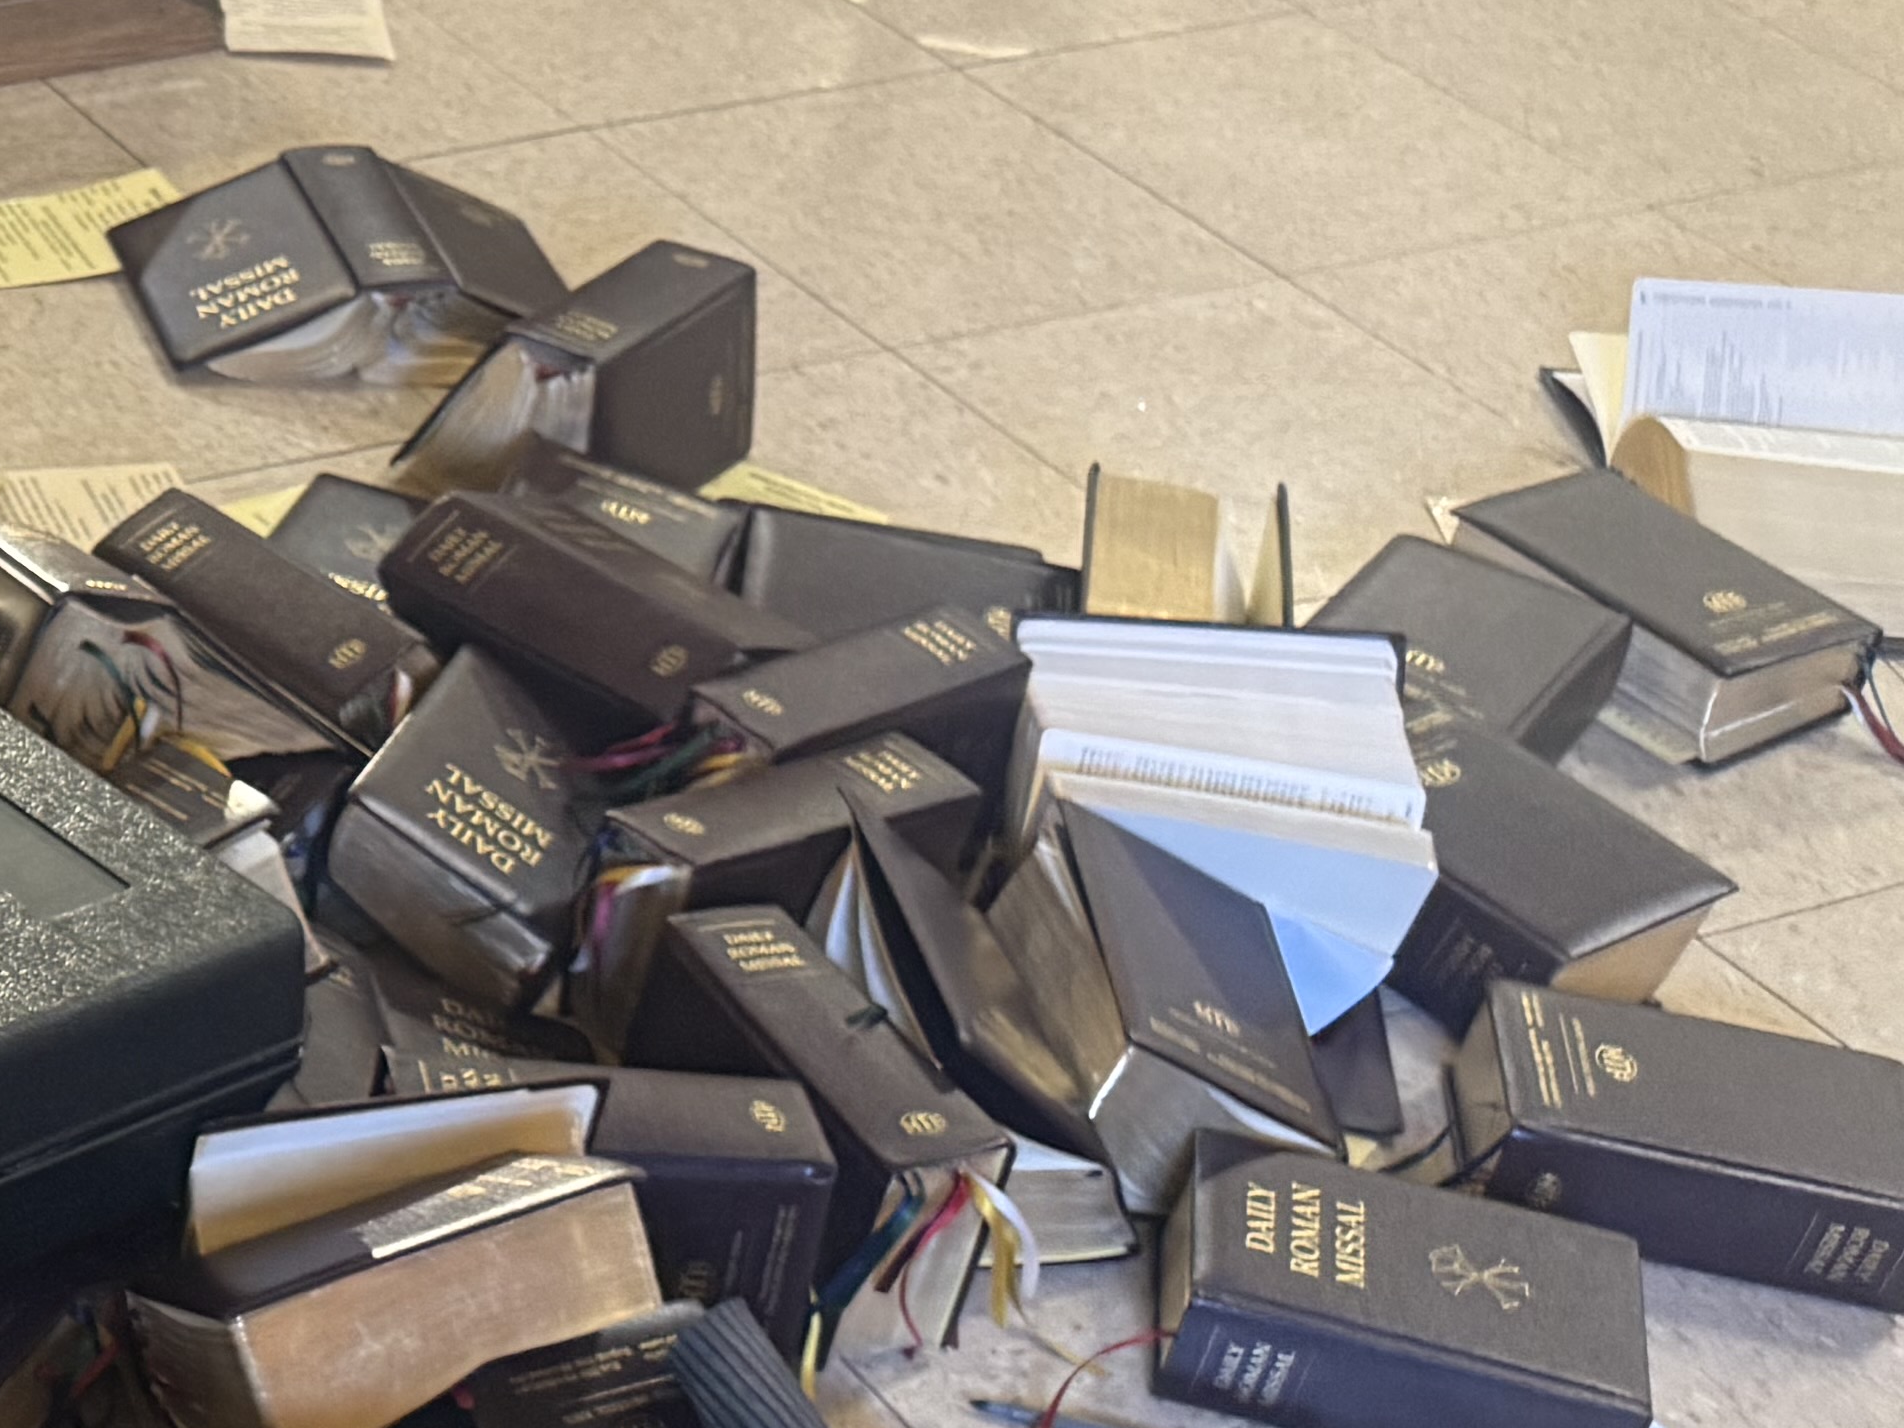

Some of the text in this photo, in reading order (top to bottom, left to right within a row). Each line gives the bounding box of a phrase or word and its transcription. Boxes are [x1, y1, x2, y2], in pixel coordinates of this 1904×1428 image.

[189, 254, 290, 300] MISSAL
[197, 268, 301, 320] ROMAN
[218, 286, 296, 330] DAILY
[424, 778, 542, 868] ROMAN
[445, 762, 553, 848] MISSAL
[426, 811, 514, 874] DAILY
[1246, 1181, 1276, 1254] DAILY
[1290, 1183, 1322, 1278] ROMAN
[1335, 1199, 1368, 1290] MISSAL
